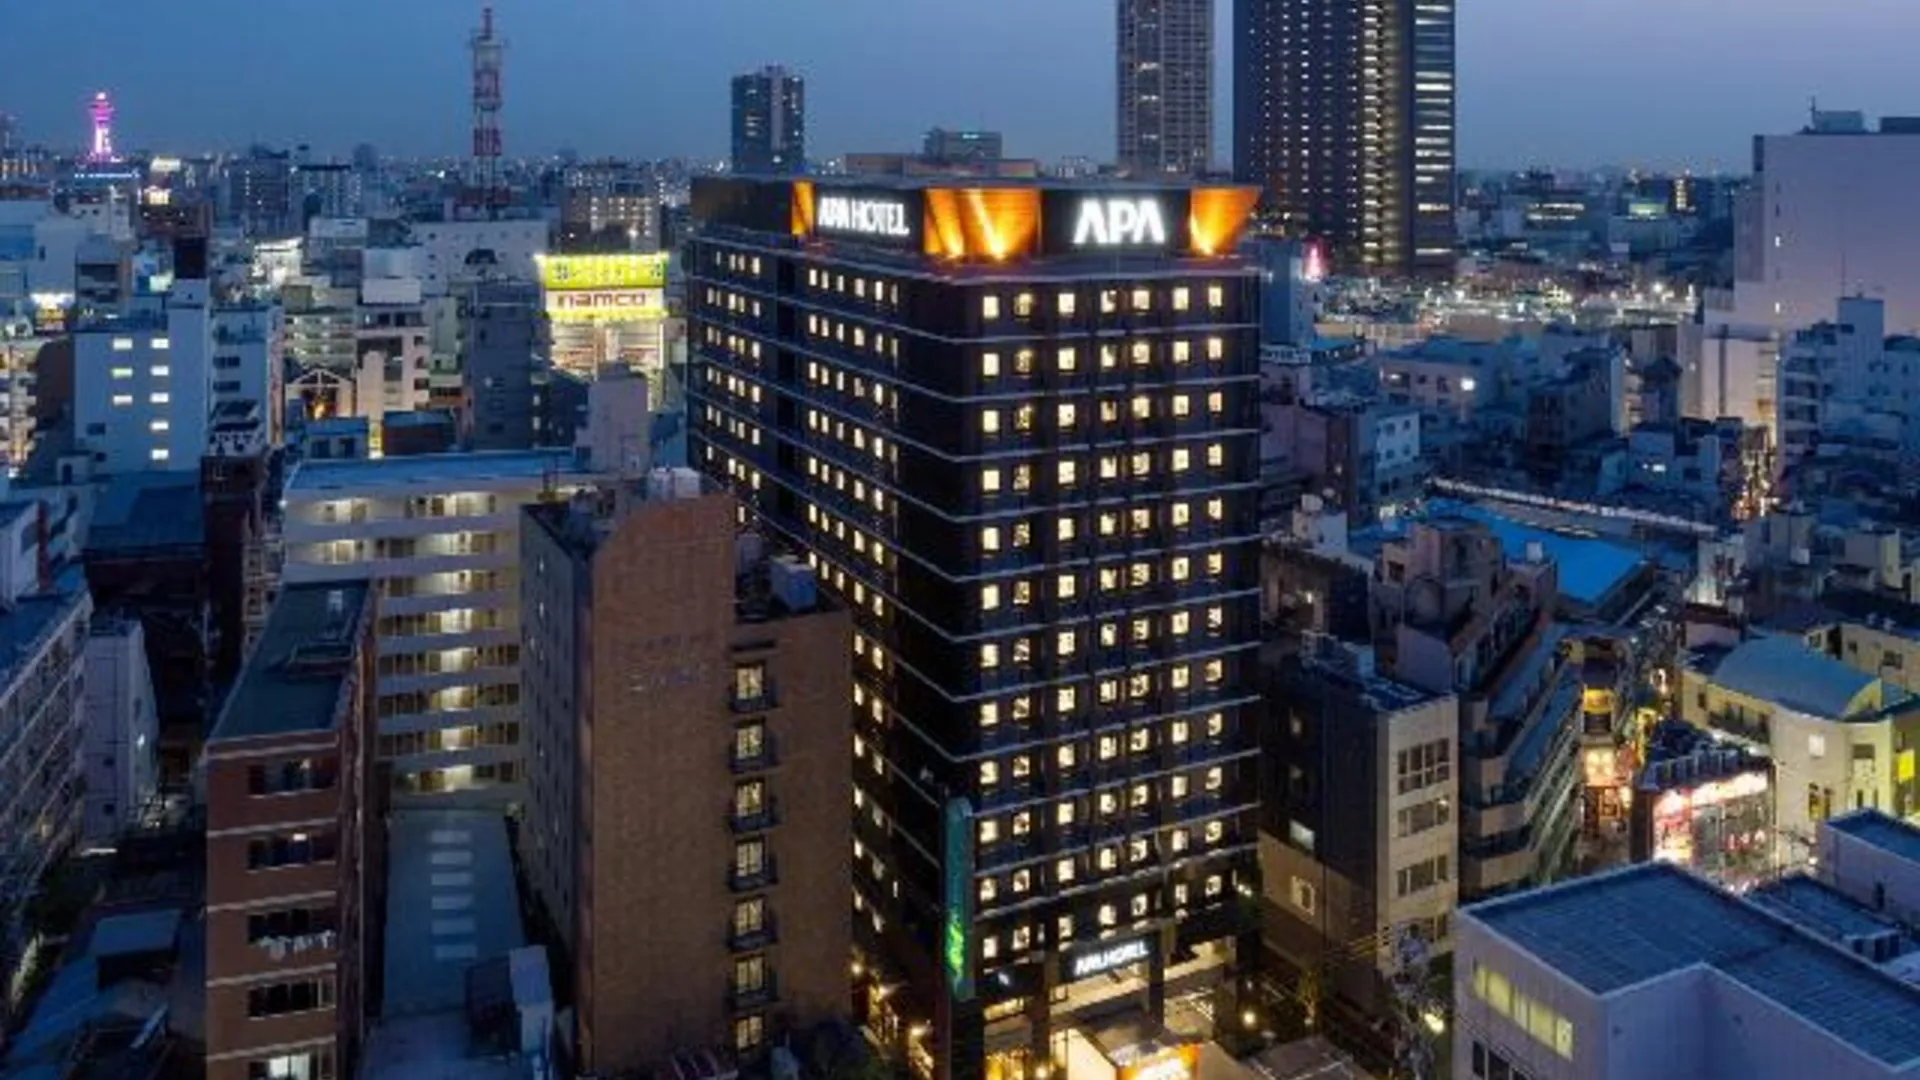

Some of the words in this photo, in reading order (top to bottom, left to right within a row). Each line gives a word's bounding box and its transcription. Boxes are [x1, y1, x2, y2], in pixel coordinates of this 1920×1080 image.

[818, 197, 849, 229] APA
[851, 199, 910, 235] HOTEL
[1073, 198, 1166, 245] APA
[557, 292, 646, 308] namco
